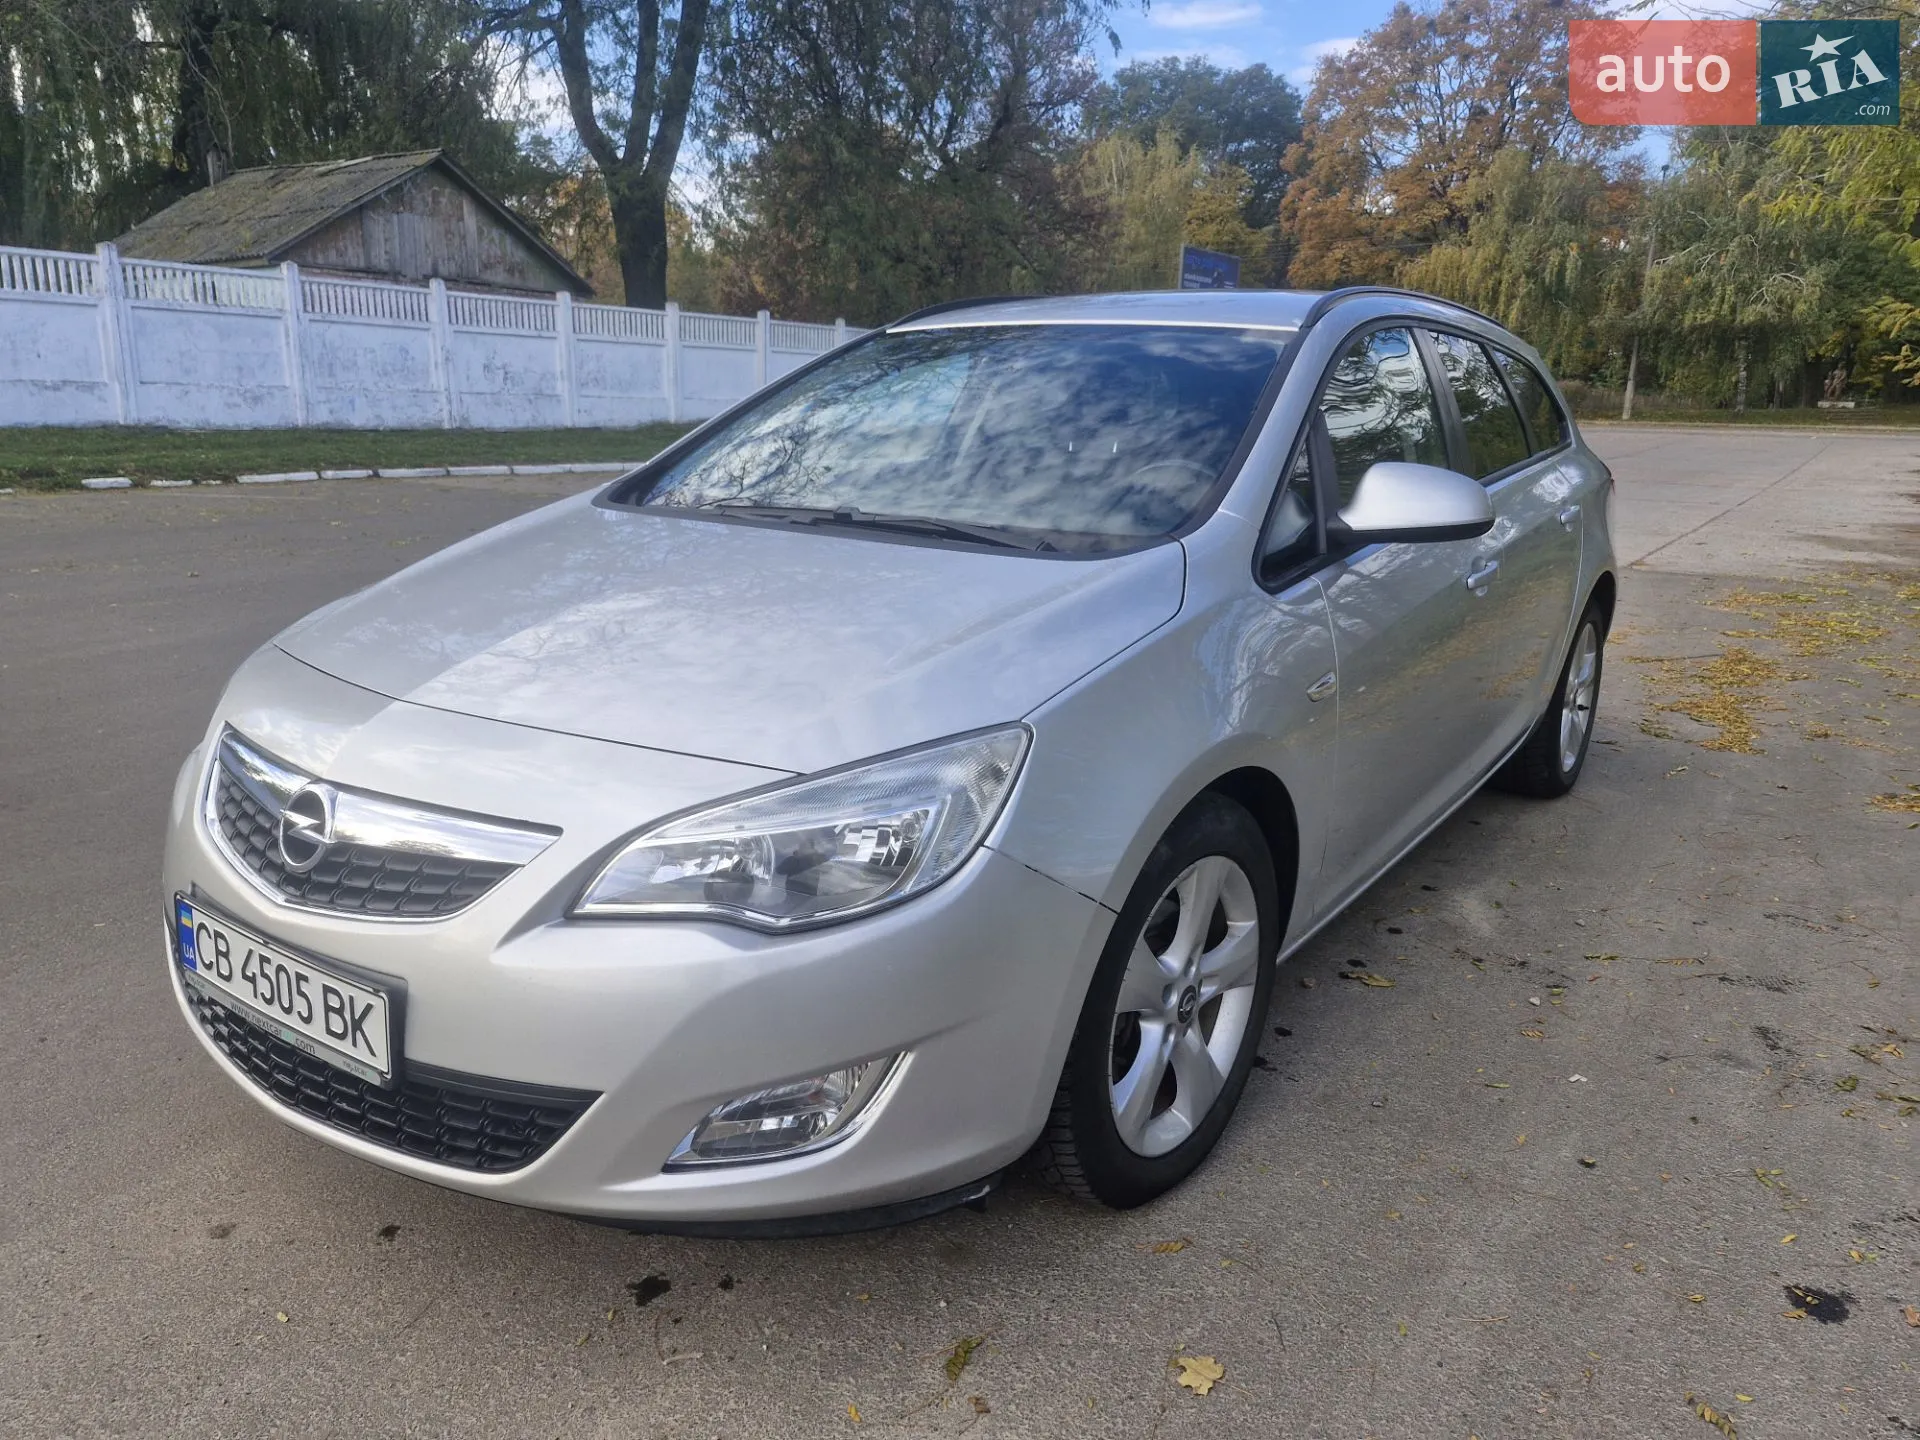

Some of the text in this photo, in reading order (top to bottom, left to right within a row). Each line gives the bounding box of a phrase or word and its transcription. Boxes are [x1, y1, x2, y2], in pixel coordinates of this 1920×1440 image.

[182, 942, 196, 962] UA
[195, 921, 377, 1058] CB 4505 BK
